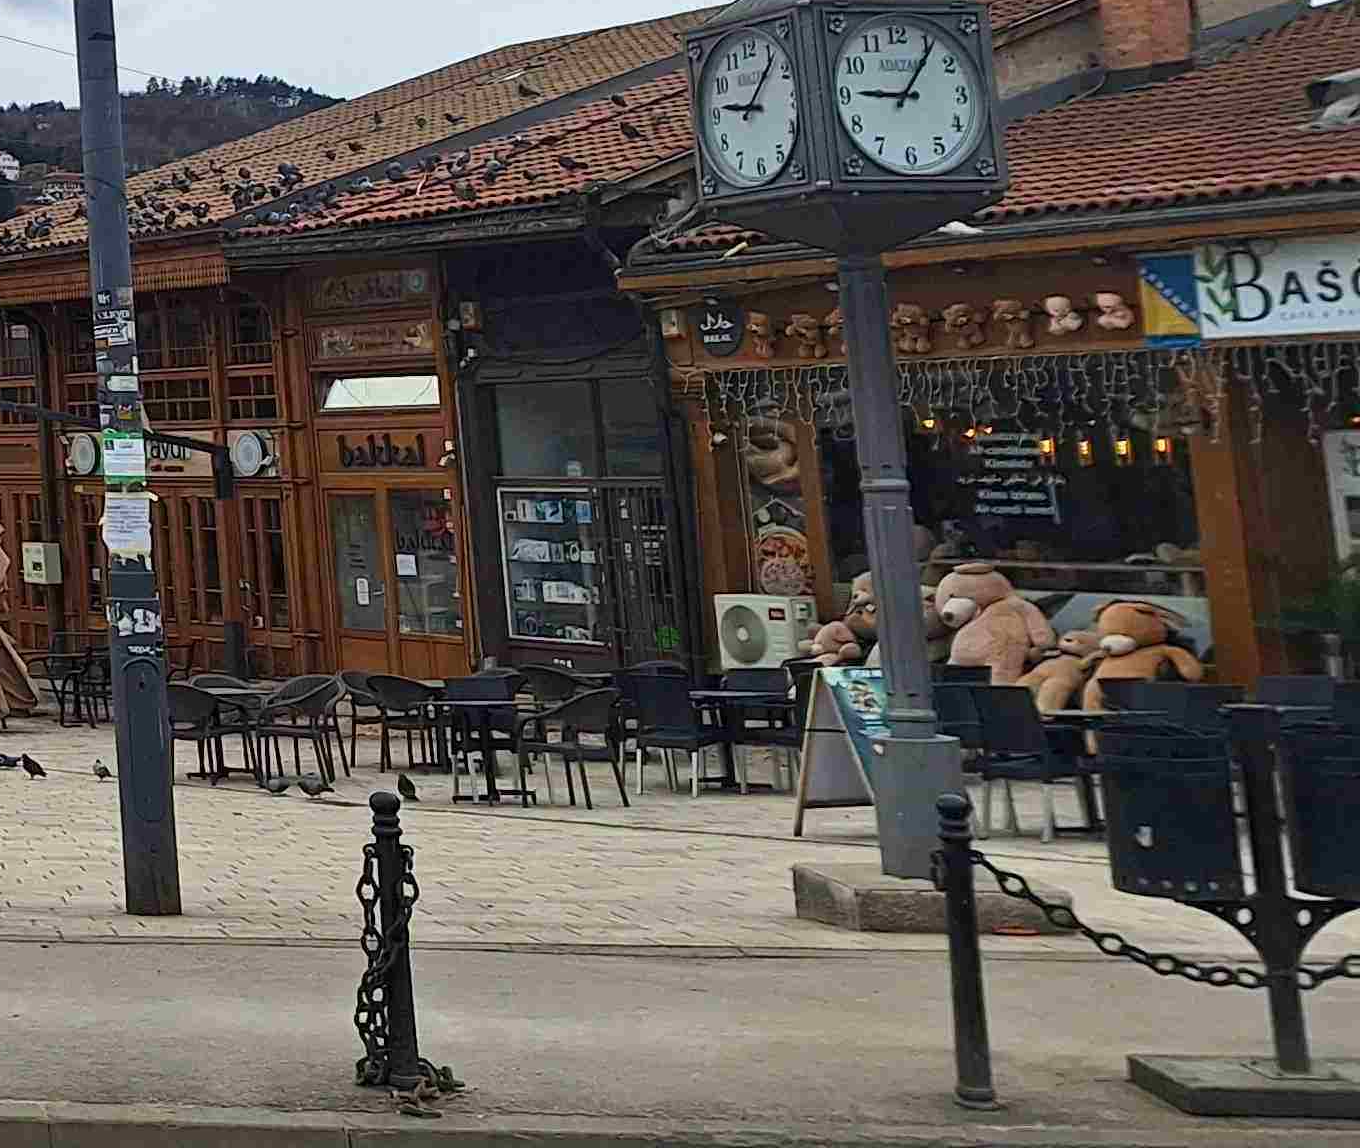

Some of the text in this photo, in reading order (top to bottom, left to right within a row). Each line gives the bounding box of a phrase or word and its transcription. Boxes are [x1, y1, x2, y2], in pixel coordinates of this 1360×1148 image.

[862, 35, 880, 52] 11
[887, 26, 908, 45] 12
[742, 40, 756, 60] 12
[727, 53, 738, 71] 11
[781, 63, 790, 79] 2
[846, 56, 865, 75] 10
[943, 56, 956, 74] 2
[716, 76, 729, 95] 10
[839, 85, 851, 105] 9
[955, 85, 968, 104] 3
[712, 107, 721, 126] 9
[851, 114, 863, 133] 8
[952, 113, 964, 132] 4
[720, 133, 729, 152] 8
[874, 136, 885, 155] 7
[933, 136, 946, 156] 5
[736, 151, 744, 171] 7
[776, 143, 785, 163] 5
[905, 146, 918, 165] 6
[756, 157, 766, 176] 6
[336, 433, 425, 467] bakkal
